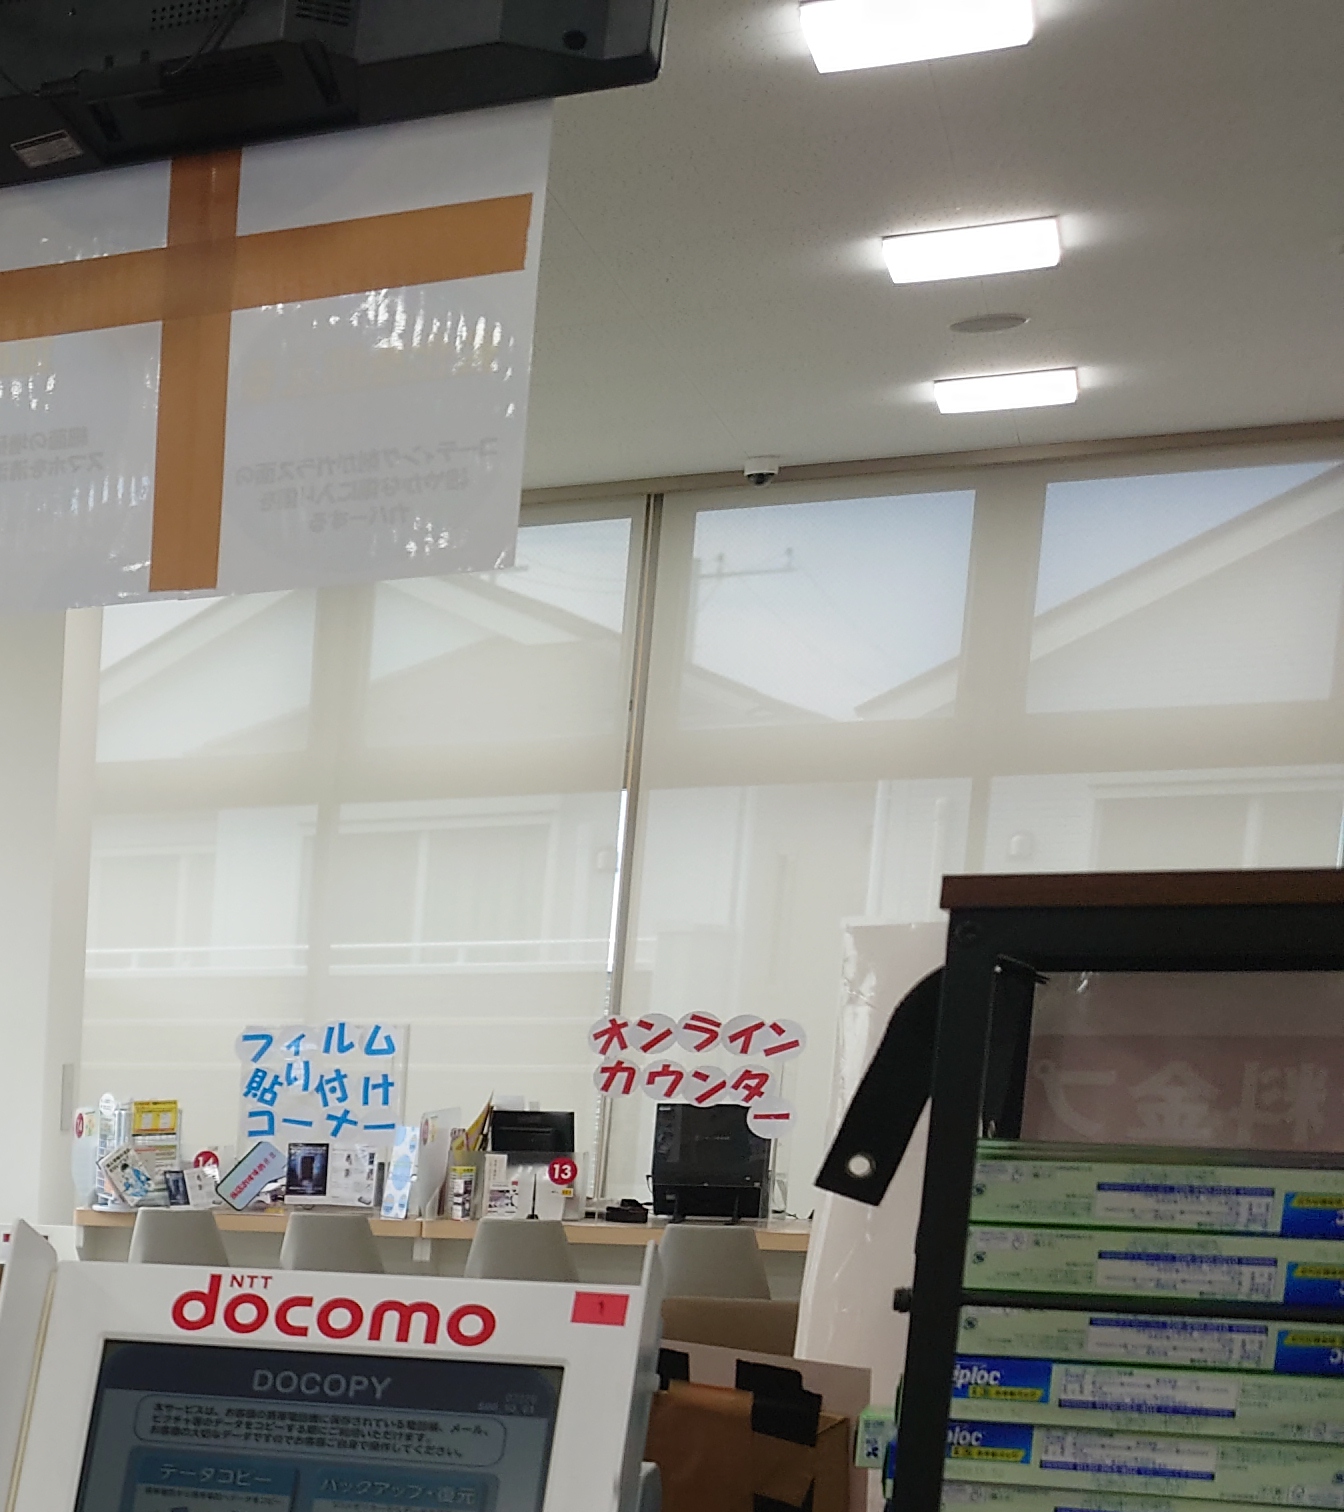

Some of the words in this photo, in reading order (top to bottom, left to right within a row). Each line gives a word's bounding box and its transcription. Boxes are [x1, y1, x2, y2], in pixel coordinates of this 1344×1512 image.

[241, 1022, 398, 1063] フィルム
[591, 1013, 803, 1059] オンライン
[243, 1057, 397, 1108] 貼り付け
[599, 1058, 792, 1123] カウンター
[552, 1164, 573, 1178] 13
[230, 1274, 273, 1289] NTT
[171, 1273, 496, 1347] docomo
[252, 1368, 394, 1401] DOCOPY
[159, 1463, 273, 1487] データコピー
